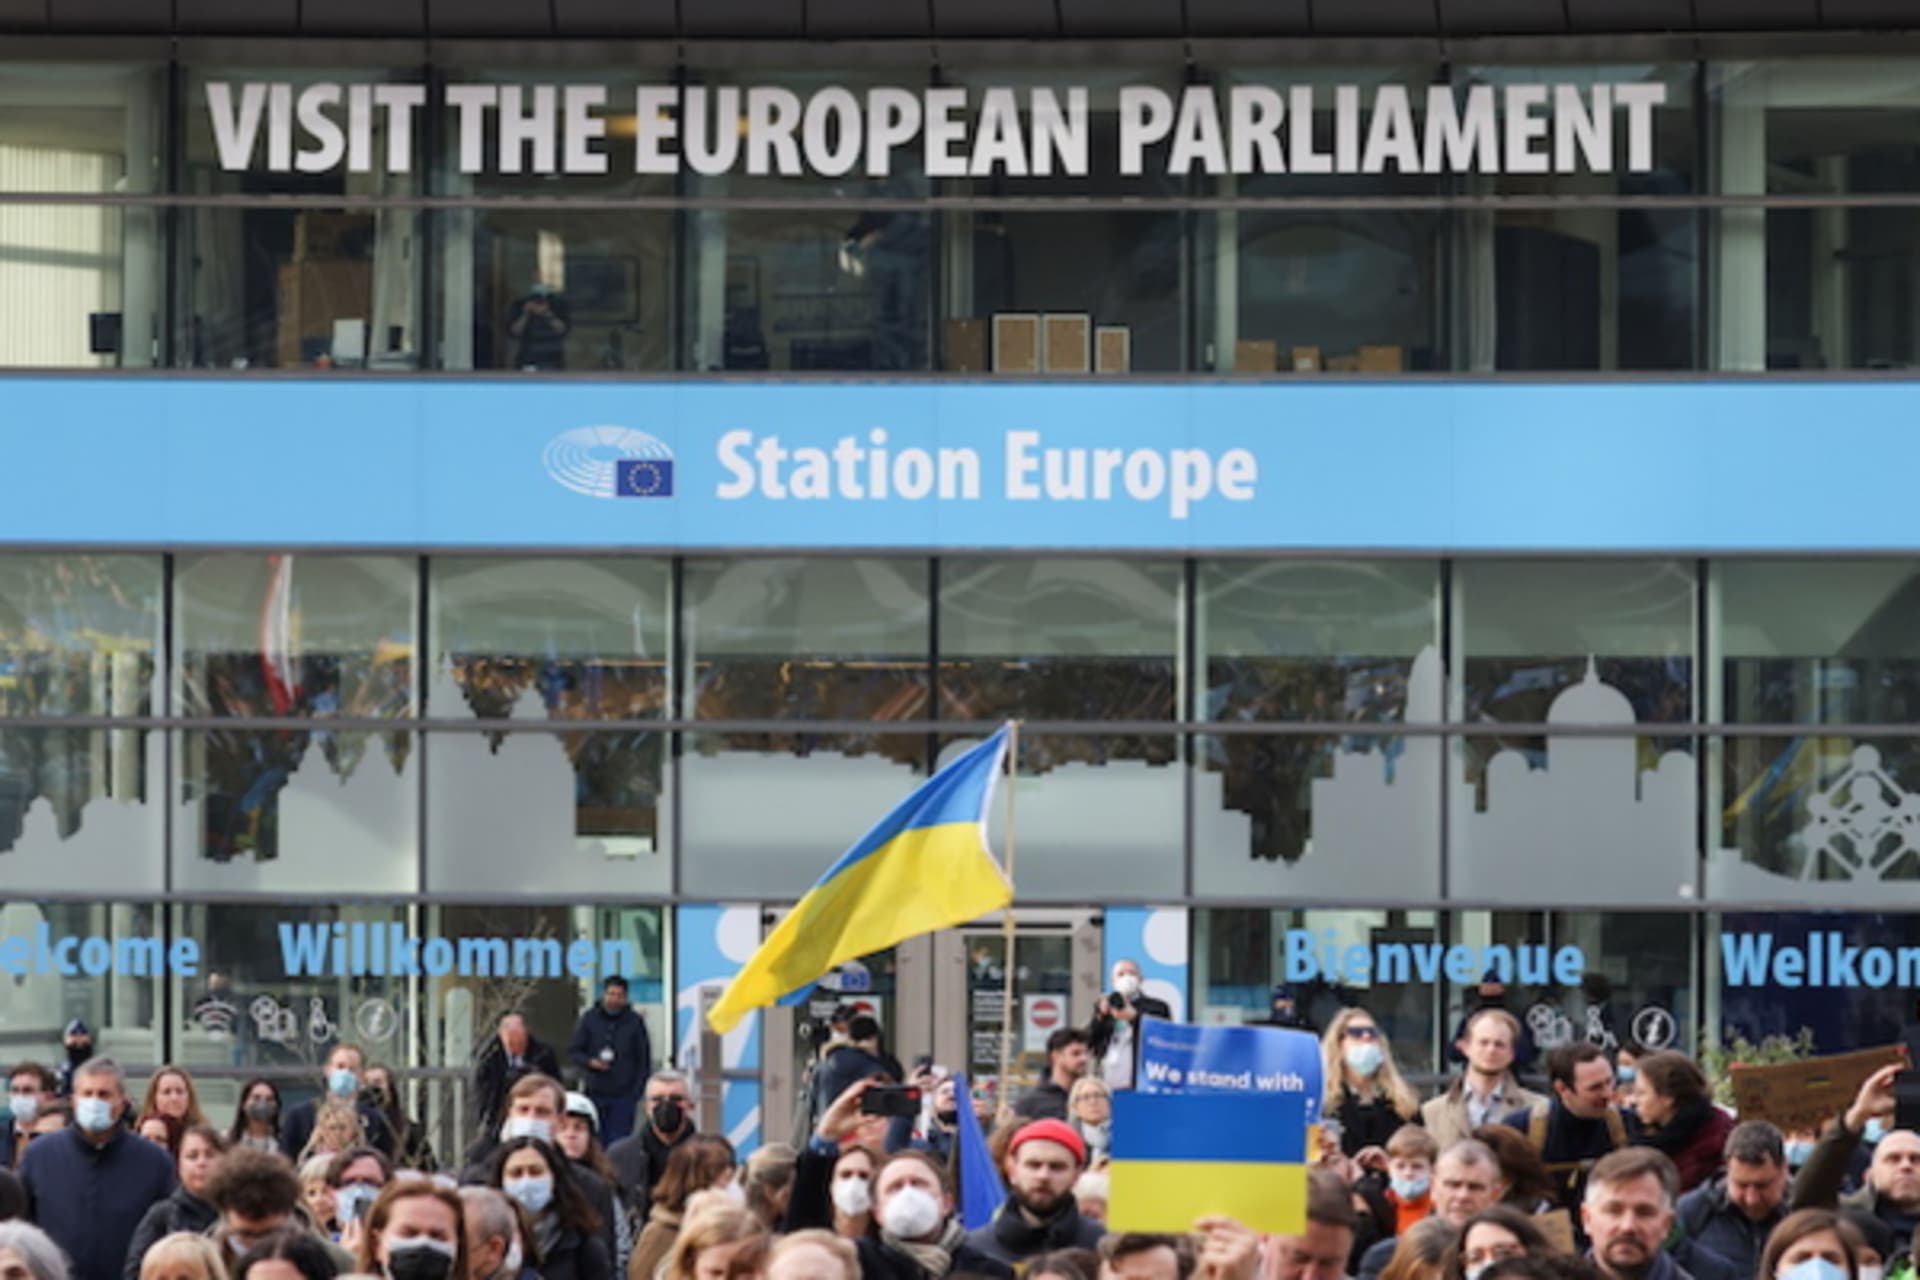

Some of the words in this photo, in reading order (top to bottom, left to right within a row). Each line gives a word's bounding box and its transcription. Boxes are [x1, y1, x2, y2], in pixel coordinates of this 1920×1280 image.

[207, 83, 425, 173] VISIT
[446, 84, 607, 175] THE
[635, 86, 1088, 177] EUROPEAN
[1120, 83, 1667, 175] PARLIAMENT
[715, 427, 981, 501] Station
[1005, 430, 1259, 519] Europe
[0, 920, 200, 977] elcome
[278, 921, 636, 979] Willkommen
[1285, 928, 1586, 985] Bienvenue
[1145, 1060, 1183, 1084] We
[1186, 1069, 1251, 1090] stand
[1255, 1071, 1305, 1092] with
